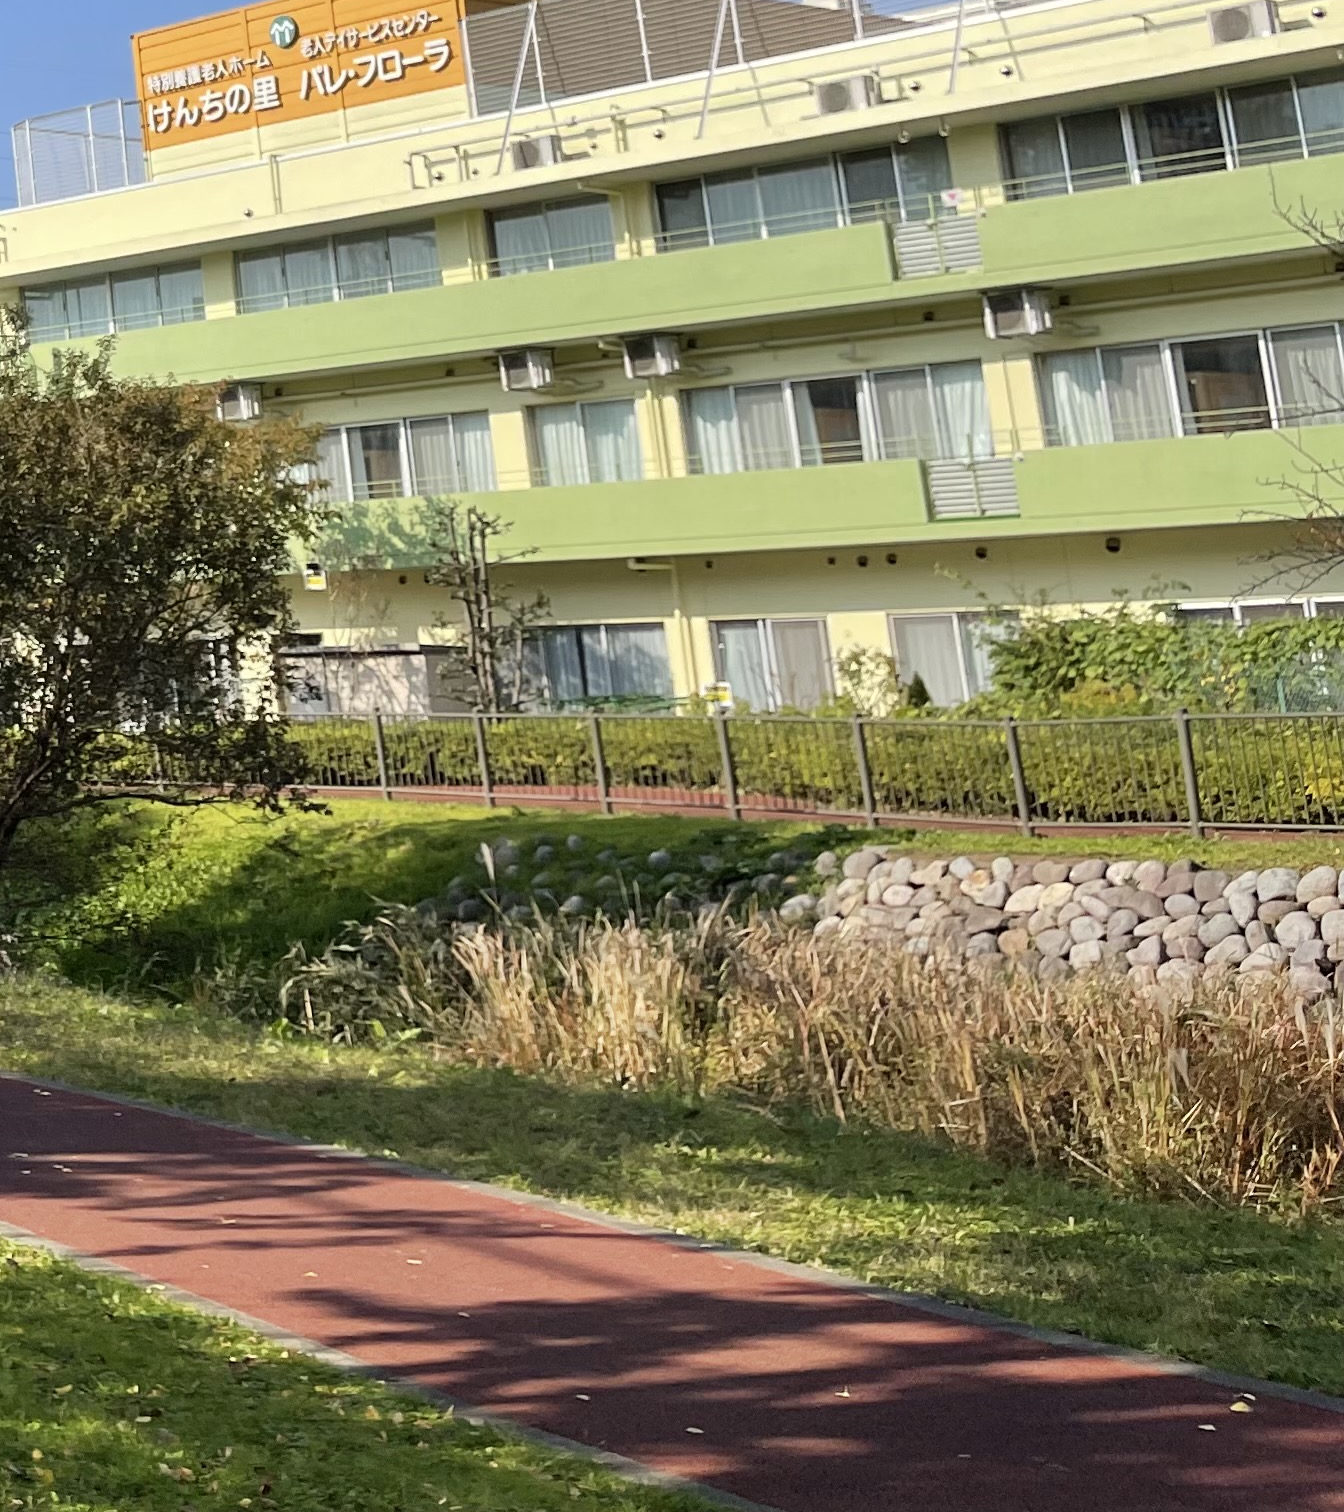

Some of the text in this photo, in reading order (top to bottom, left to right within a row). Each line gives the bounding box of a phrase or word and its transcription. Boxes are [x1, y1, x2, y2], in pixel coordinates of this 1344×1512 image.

[300, 38, 449, 99] パレ・フローラ
[149, 76, 280, 132] けんちの里
